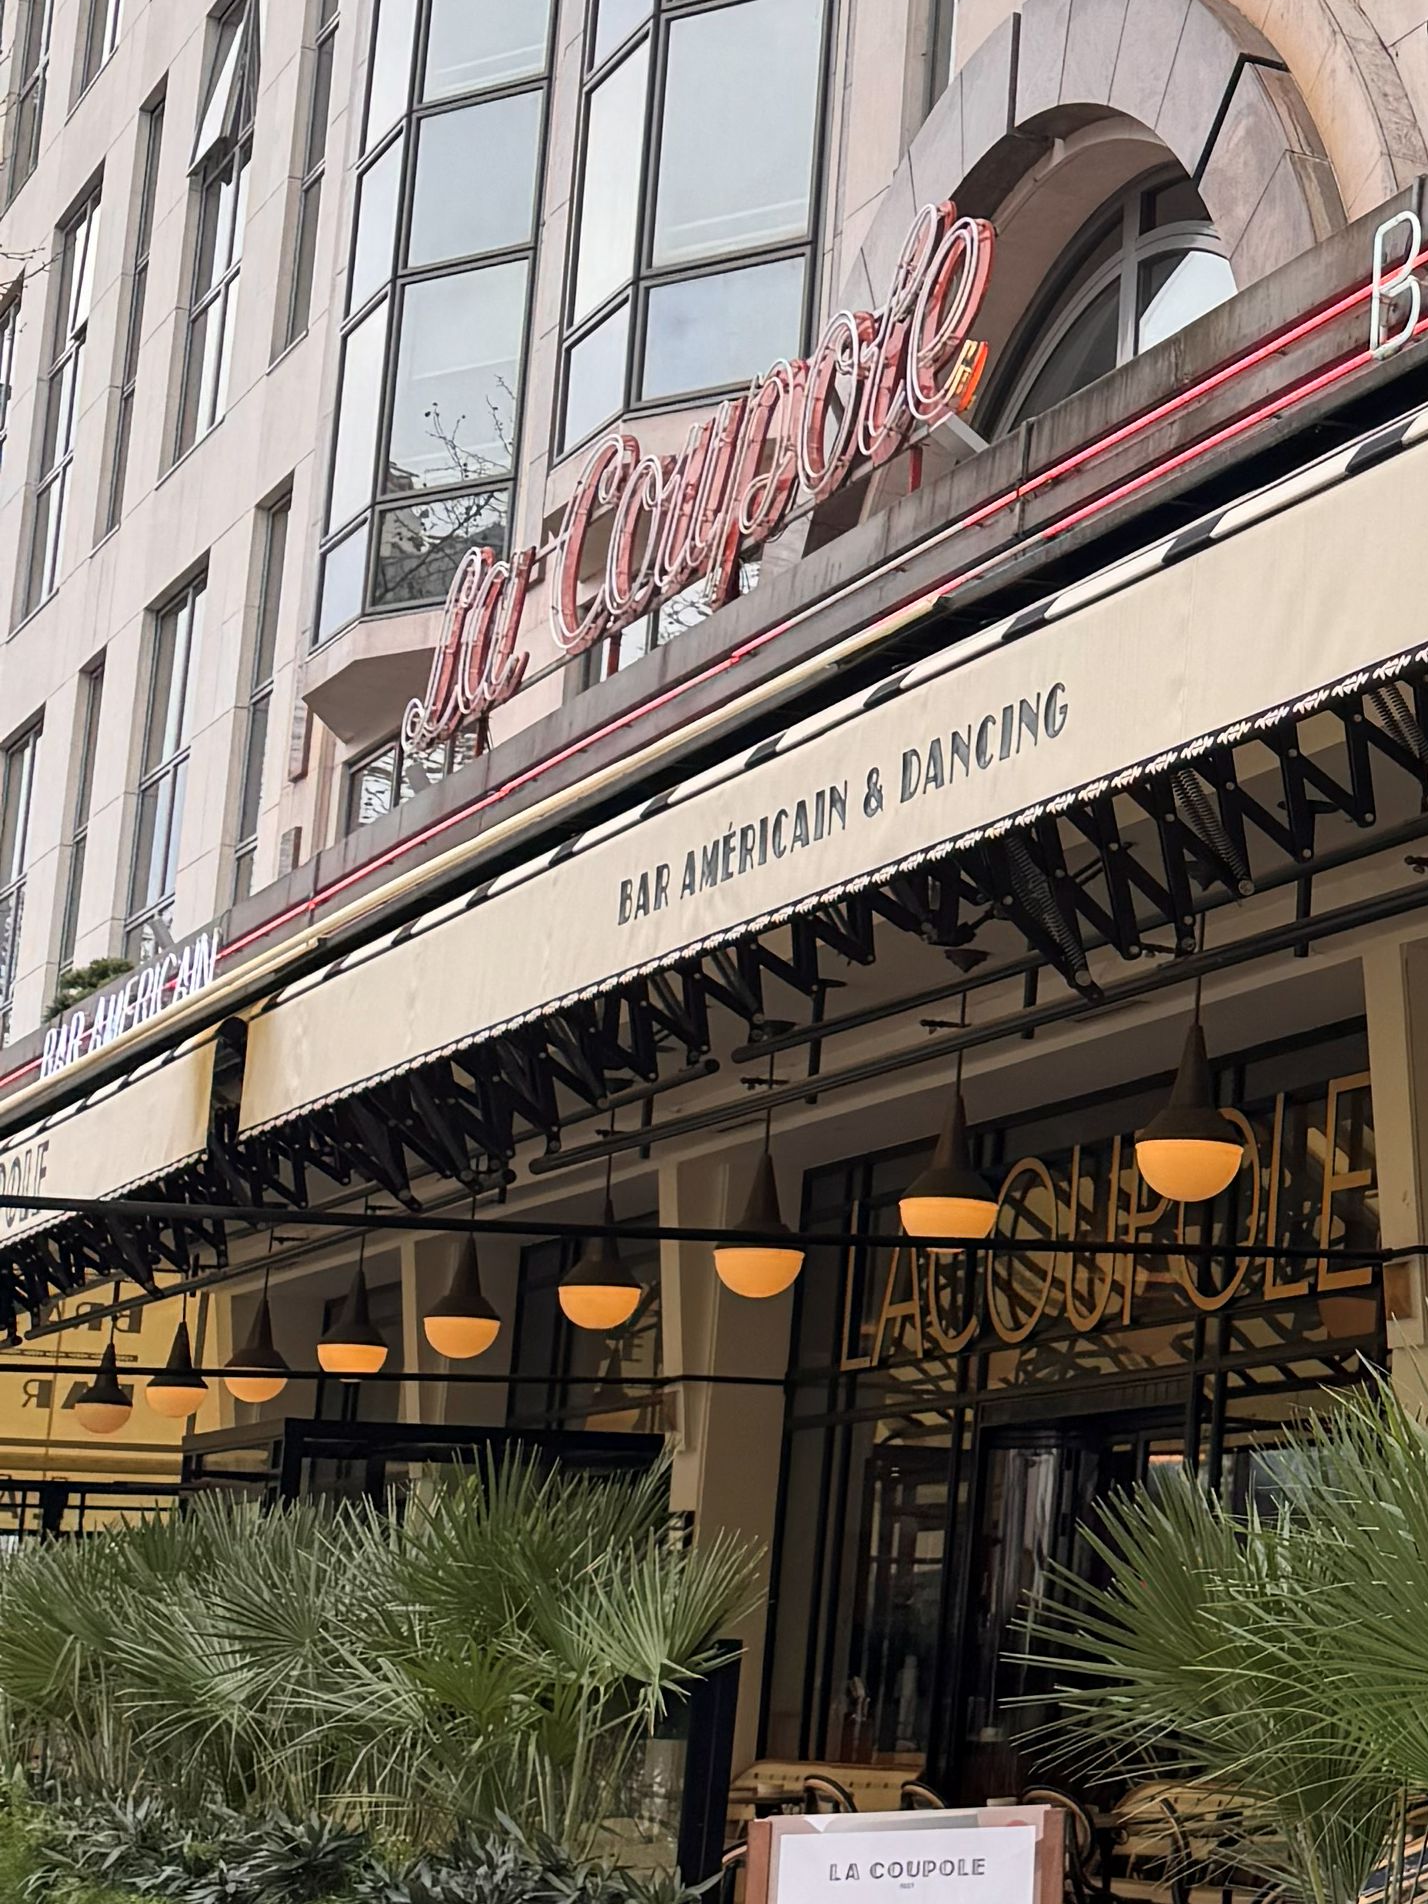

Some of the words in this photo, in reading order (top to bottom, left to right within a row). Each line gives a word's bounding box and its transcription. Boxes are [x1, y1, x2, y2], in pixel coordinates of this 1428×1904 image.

[618, 870, 670, 926] BAR
[681, 779, 848, 900] AMÉRICAIN
[863, 767, 884, 818] &
[900, 682, 1069, 804] DANCING
[40, 1010, 86, 1080] BAR
[829, 1863, 861, 1881] LA
[869, 1858, 986, 1880] COUPOLE
